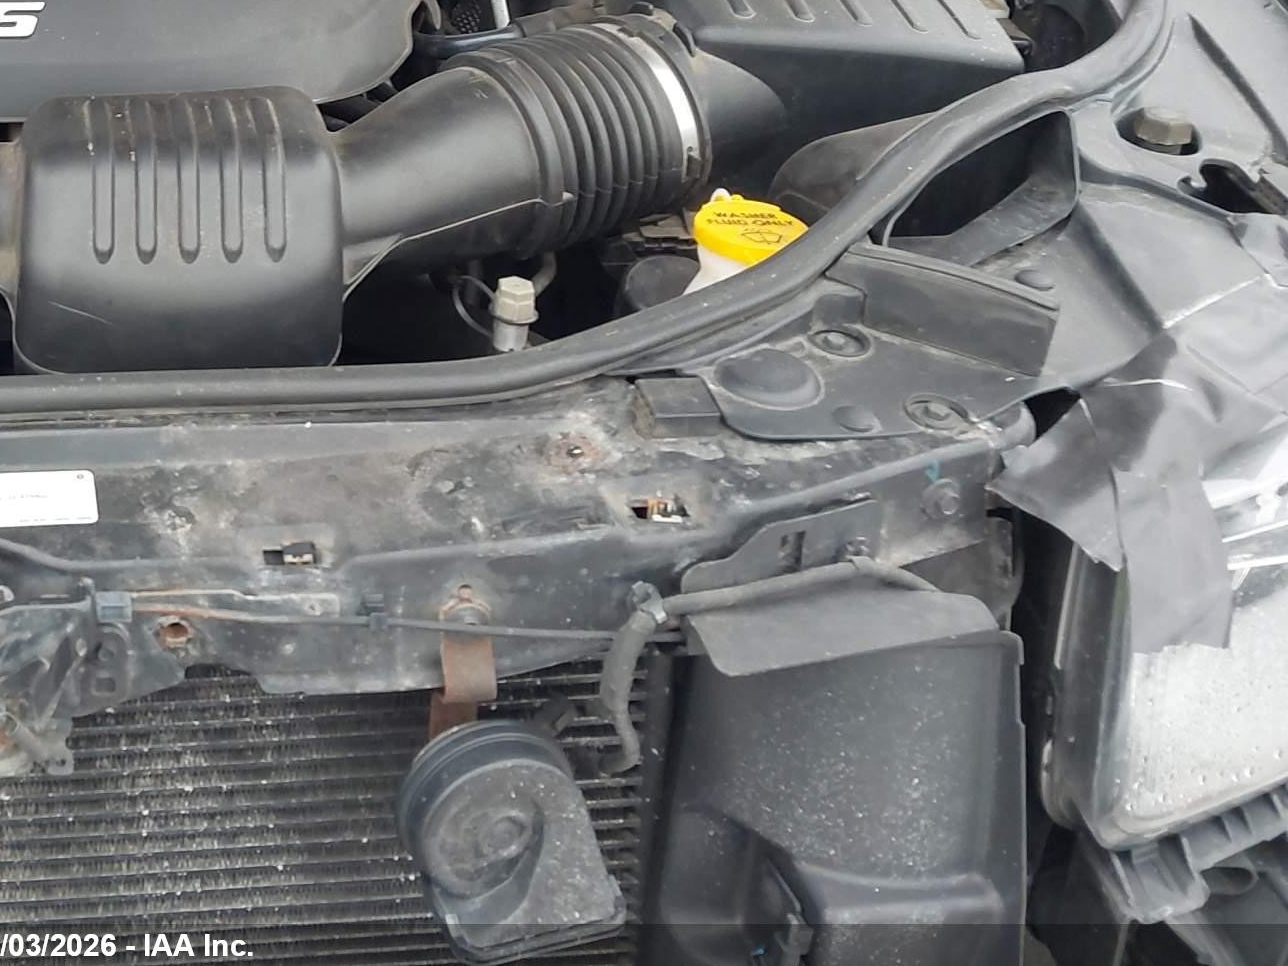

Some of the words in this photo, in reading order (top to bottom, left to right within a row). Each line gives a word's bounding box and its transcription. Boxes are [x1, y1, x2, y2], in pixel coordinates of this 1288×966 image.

[714, 211, 778, 220] WASHER
[707, 218, 748, 226] FLUID
[752, 219, 793, 227] ONLY
